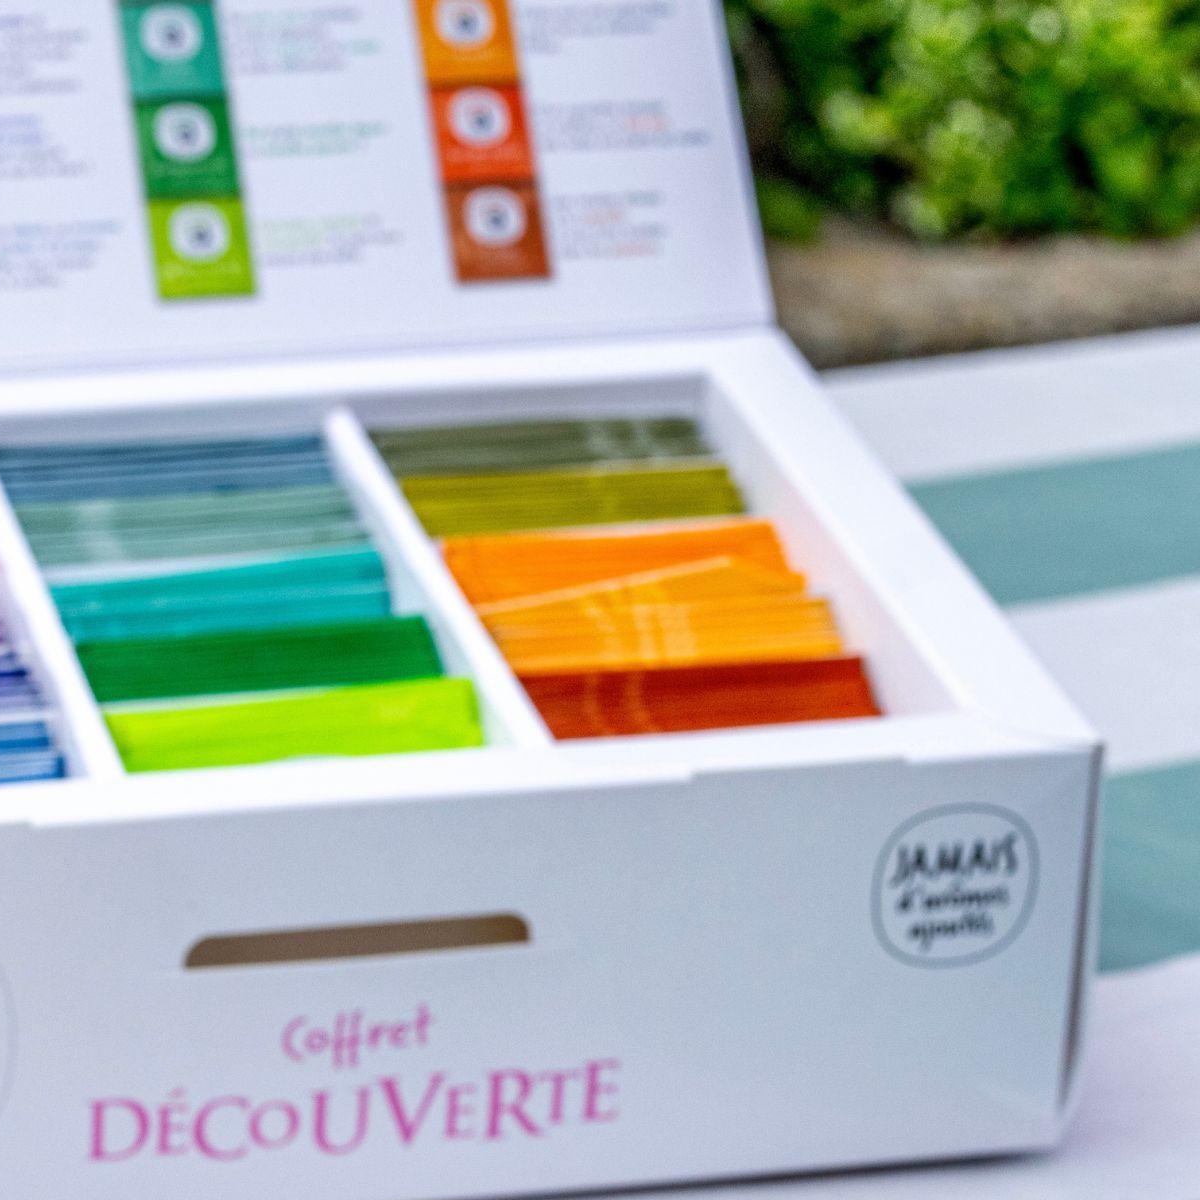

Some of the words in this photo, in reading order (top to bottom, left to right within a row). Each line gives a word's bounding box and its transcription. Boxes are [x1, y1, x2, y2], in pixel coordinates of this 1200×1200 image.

[889, 831, 1018, 889] JAMAIS
[280, 1002, 433, 1069] Coffret
[88, 1057, 621, 1162] DÉCOUVERTE
